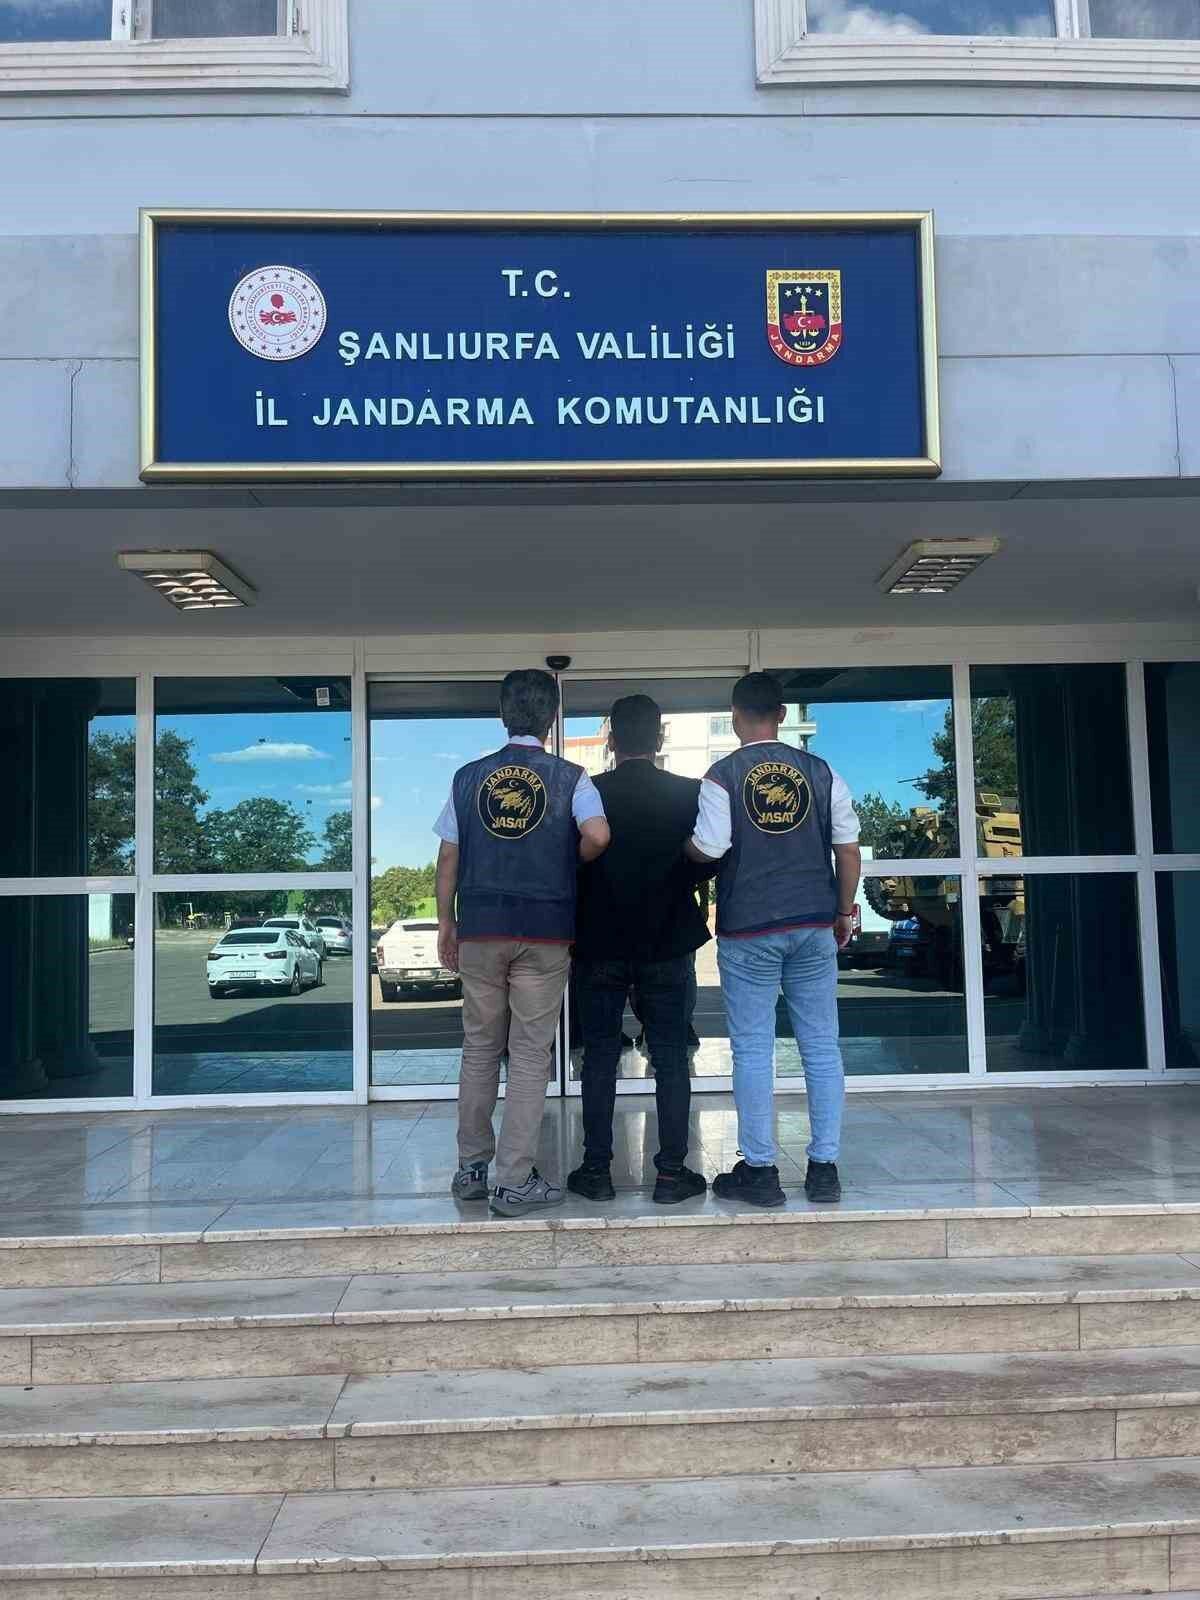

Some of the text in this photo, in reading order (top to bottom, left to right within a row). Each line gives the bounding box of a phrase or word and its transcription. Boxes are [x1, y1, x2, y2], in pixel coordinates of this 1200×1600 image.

[501, 269, 571, 298] T.C.
[338, 323, 736, 366] ŞANLIURFA VALİLİĞİ
[771, 334, 839, 363] JANDARMA
[255, 387, 826, 426] İL JANDARMA KOMUTANLIĞI
[486, 768, 541, 792] JANDARMA
[748, 764, 804, 787] JANDARMA
[492, 816, 529, 829] JASAT
[758, 811, 795, 824] JASAT
